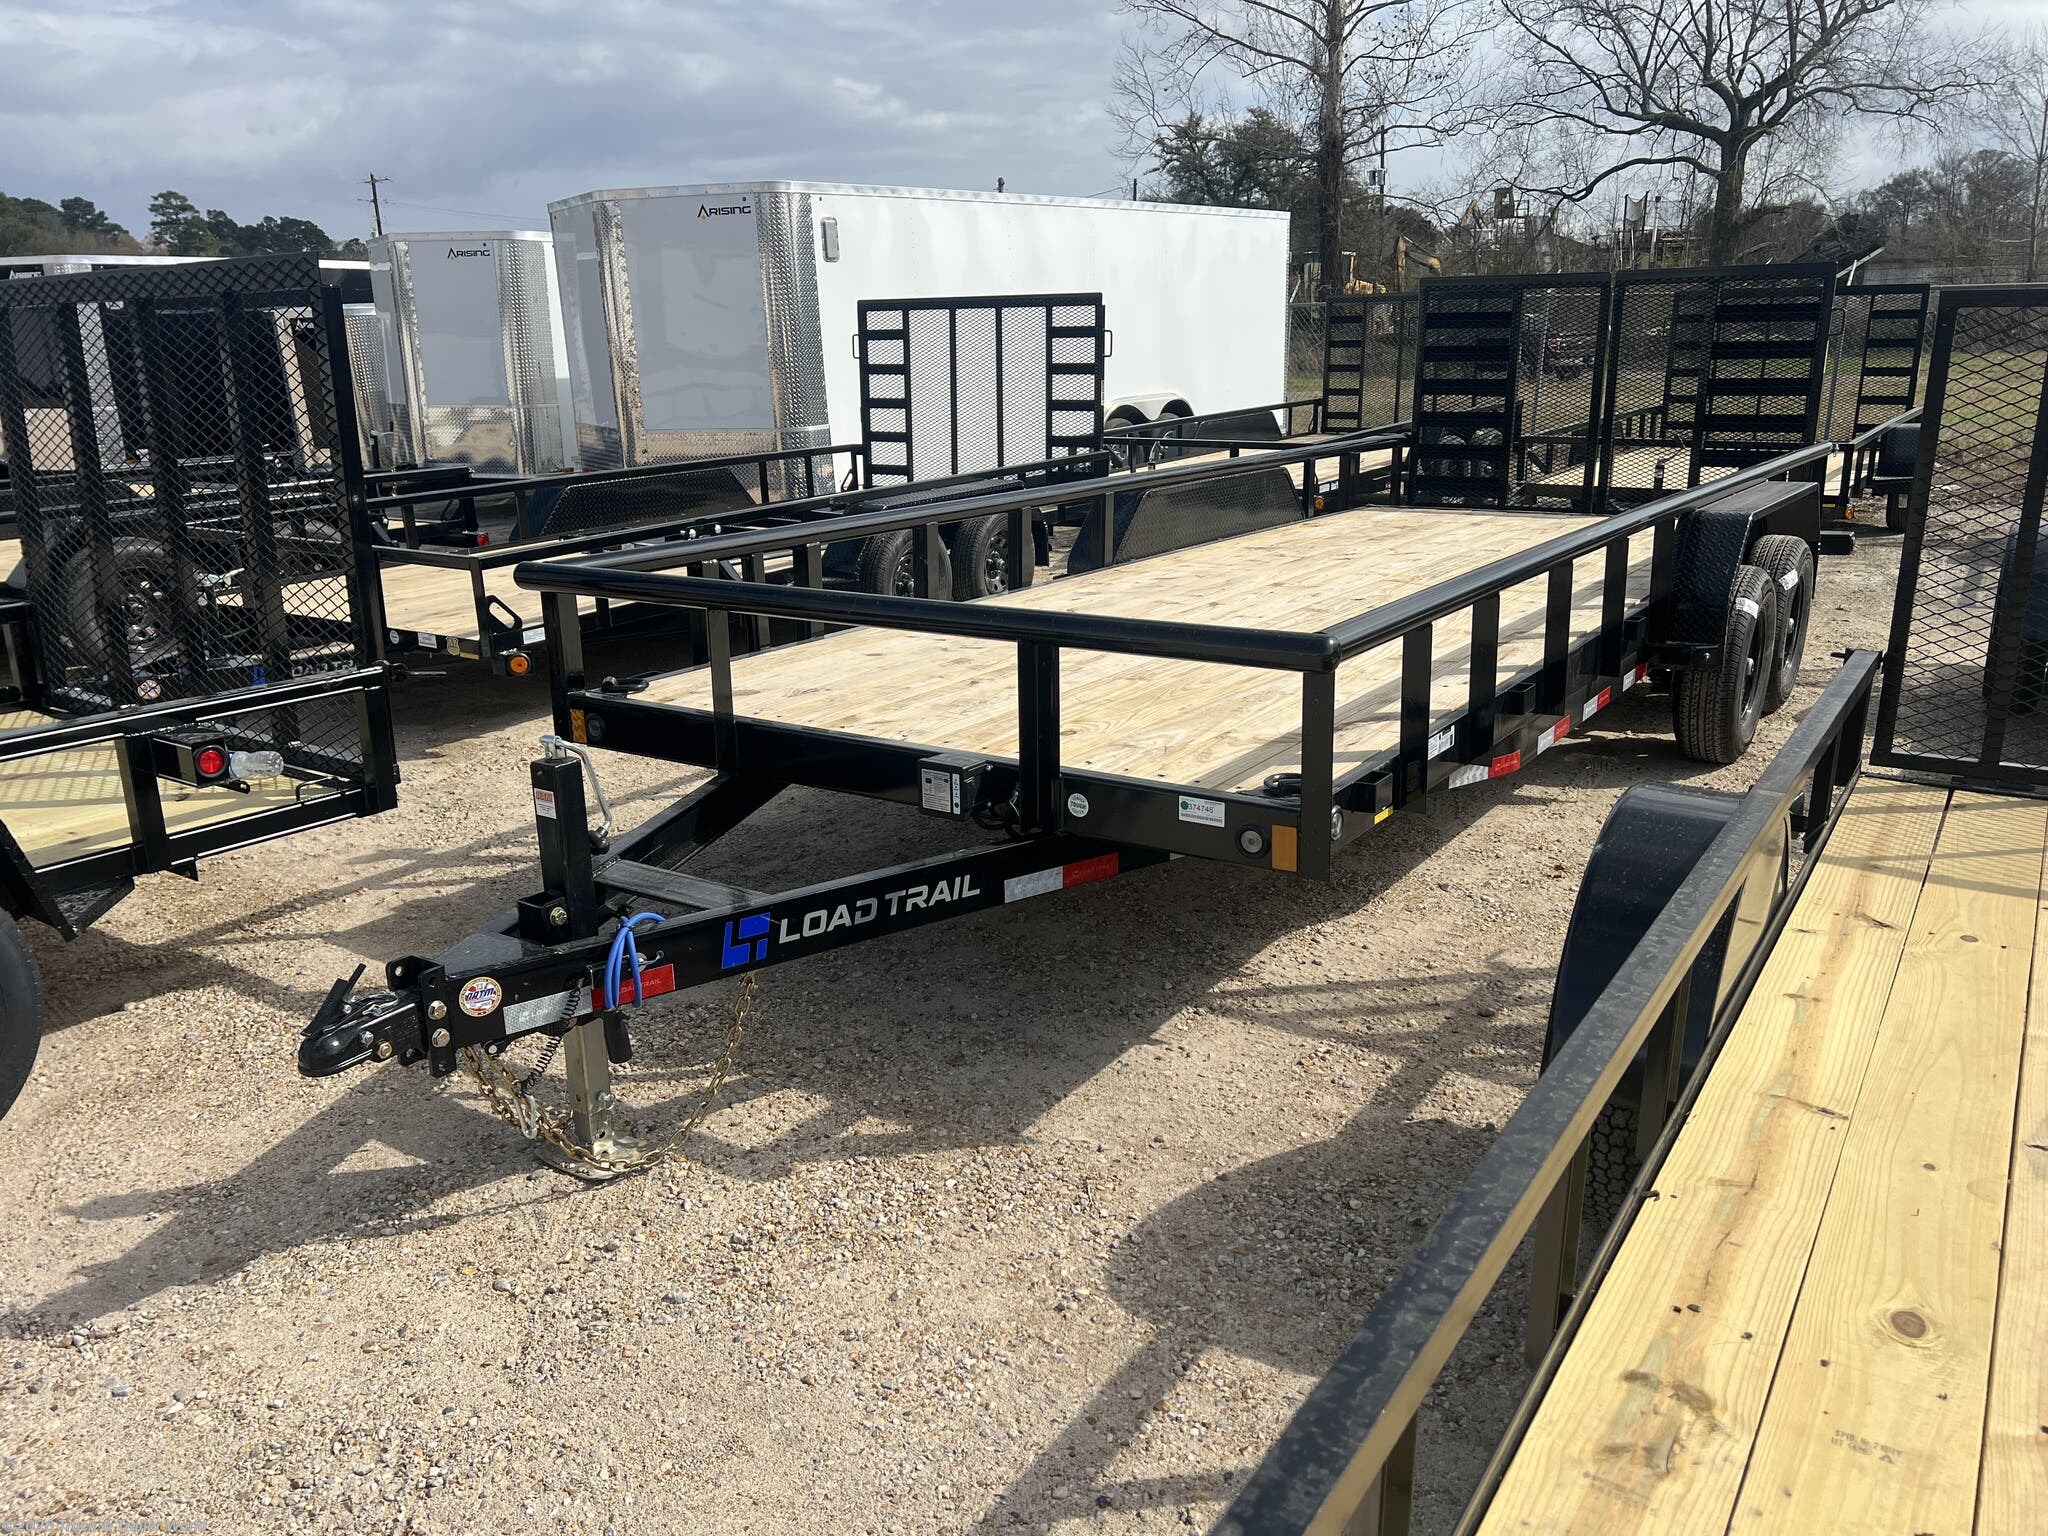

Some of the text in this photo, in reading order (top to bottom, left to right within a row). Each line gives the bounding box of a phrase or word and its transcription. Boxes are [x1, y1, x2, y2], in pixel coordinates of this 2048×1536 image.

[697, 203, 752, 218] ARISING
[447, 247, 491, 259] ARISING
[779, 874, 981, 944] LOAD TRAIL
